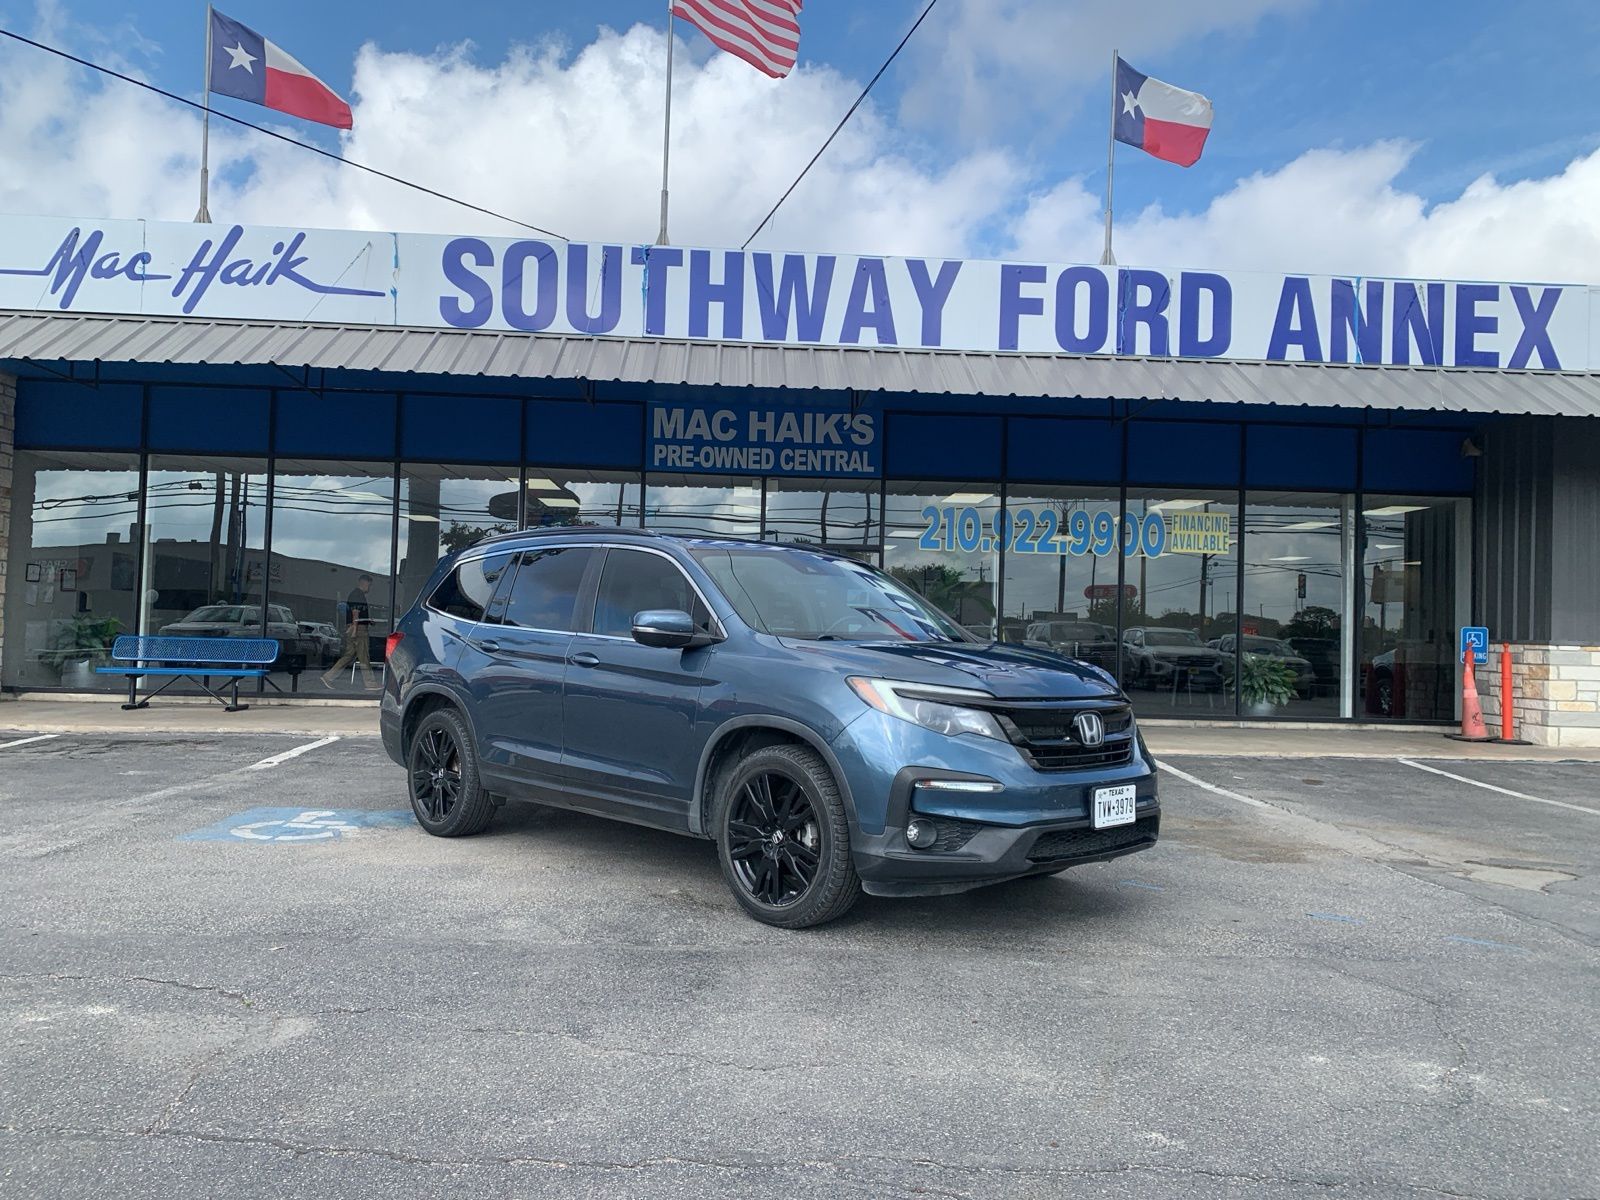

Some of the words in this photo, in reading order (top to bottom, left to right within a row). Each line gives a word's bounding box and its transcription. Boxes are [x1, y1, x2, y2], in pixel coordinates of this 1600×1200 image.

[36, 226, 171, 310] Mac
[172, 224, 372, 315] Haik
[439, 237, 963, 347] SOUTHWAY
[997, 263, 1233, 358] FORD
[1266, 275, 1564, 371] ANNEX
[653, 407, 737, 441] MAC
[749, 410, 875, 445] HAIK'S
[654, 444, 775, 471] PRE-OWNED
[780, 449, 875, 473] CENTRAL
[919, 505, 1167, 559] 210.922.9900
[1173, 515, 1228, 532] FINANCING
[1172, 533, 1228, 551] AVAILABLE
[1109, 788, 1124, 796] TEXAS
